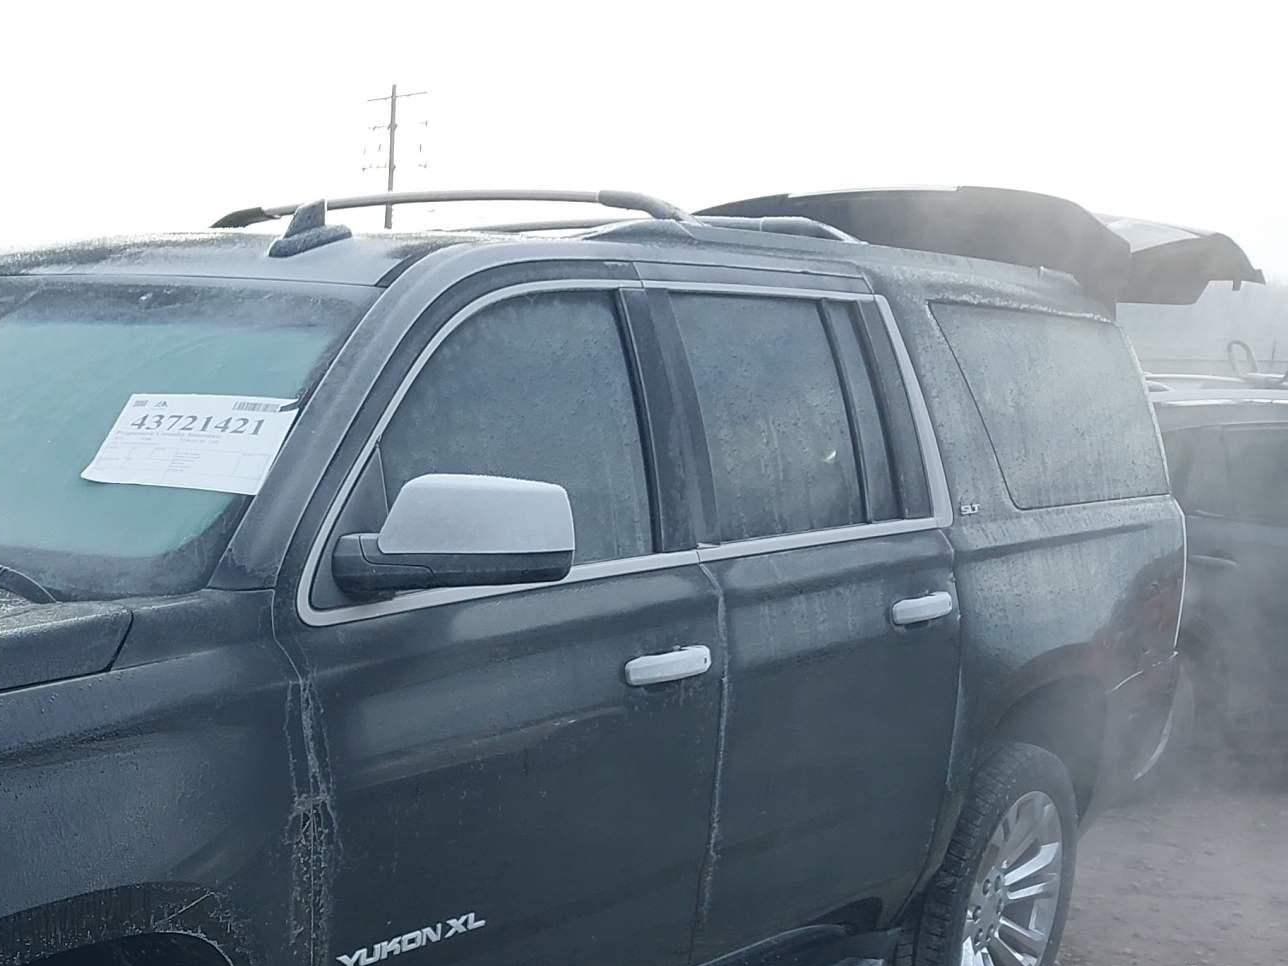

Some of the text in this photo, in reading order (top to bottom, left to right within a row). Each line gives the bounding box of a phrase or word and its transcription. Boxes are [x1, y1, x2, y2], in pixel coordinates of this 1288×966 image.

[130, 414, 265, 436] 43721421
[961, 503, 981, 515] SLT
[445, 912, 486, 938] XL
